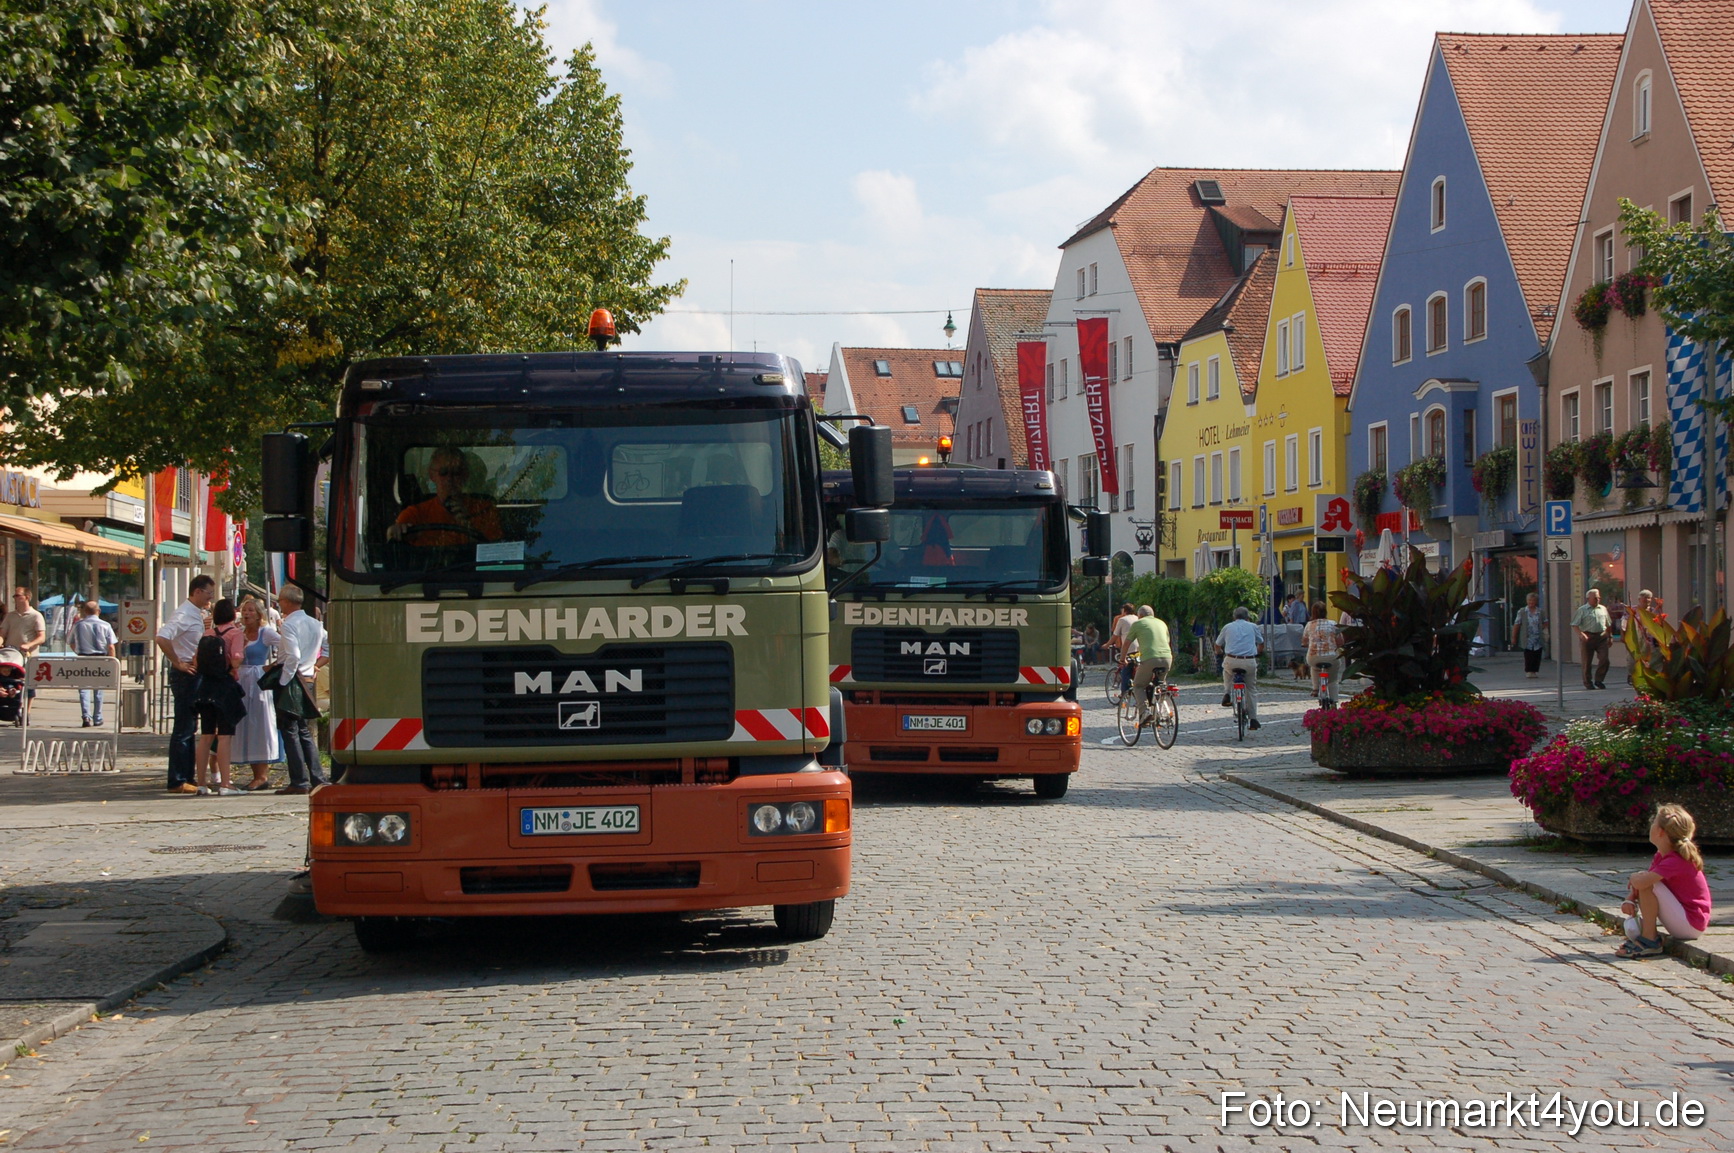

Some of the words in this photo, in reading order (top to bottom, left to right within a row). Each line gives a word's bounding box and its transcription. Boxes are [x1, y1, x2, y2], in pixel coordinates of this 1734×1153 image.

[1198, 425, 1220, 447] HOTEL
[1226, 420, 1250, 440] Lehmeier
[1260, 508, 1266, 530] P
[1551, 505, 1566, 532] P
[1197, 529, 1228, 543] Restaurant
[406, 602, 749, 643] EDENHARDER
[844, 602, 1029, 626] EDENHARDER
[901, 641, 970, 655] MAN
[56, 666, 111, 679] Apotheke
[514, 669, 642, 694] MAN
[910, 717, 923, 728] NM
[930, 717, 943, 728] JE
[946, 718, 964, 728] 401
[534, 812, 559, 830] NM
[573, 811, 596, 829] JE
[601, 810, 636, 828] 402
